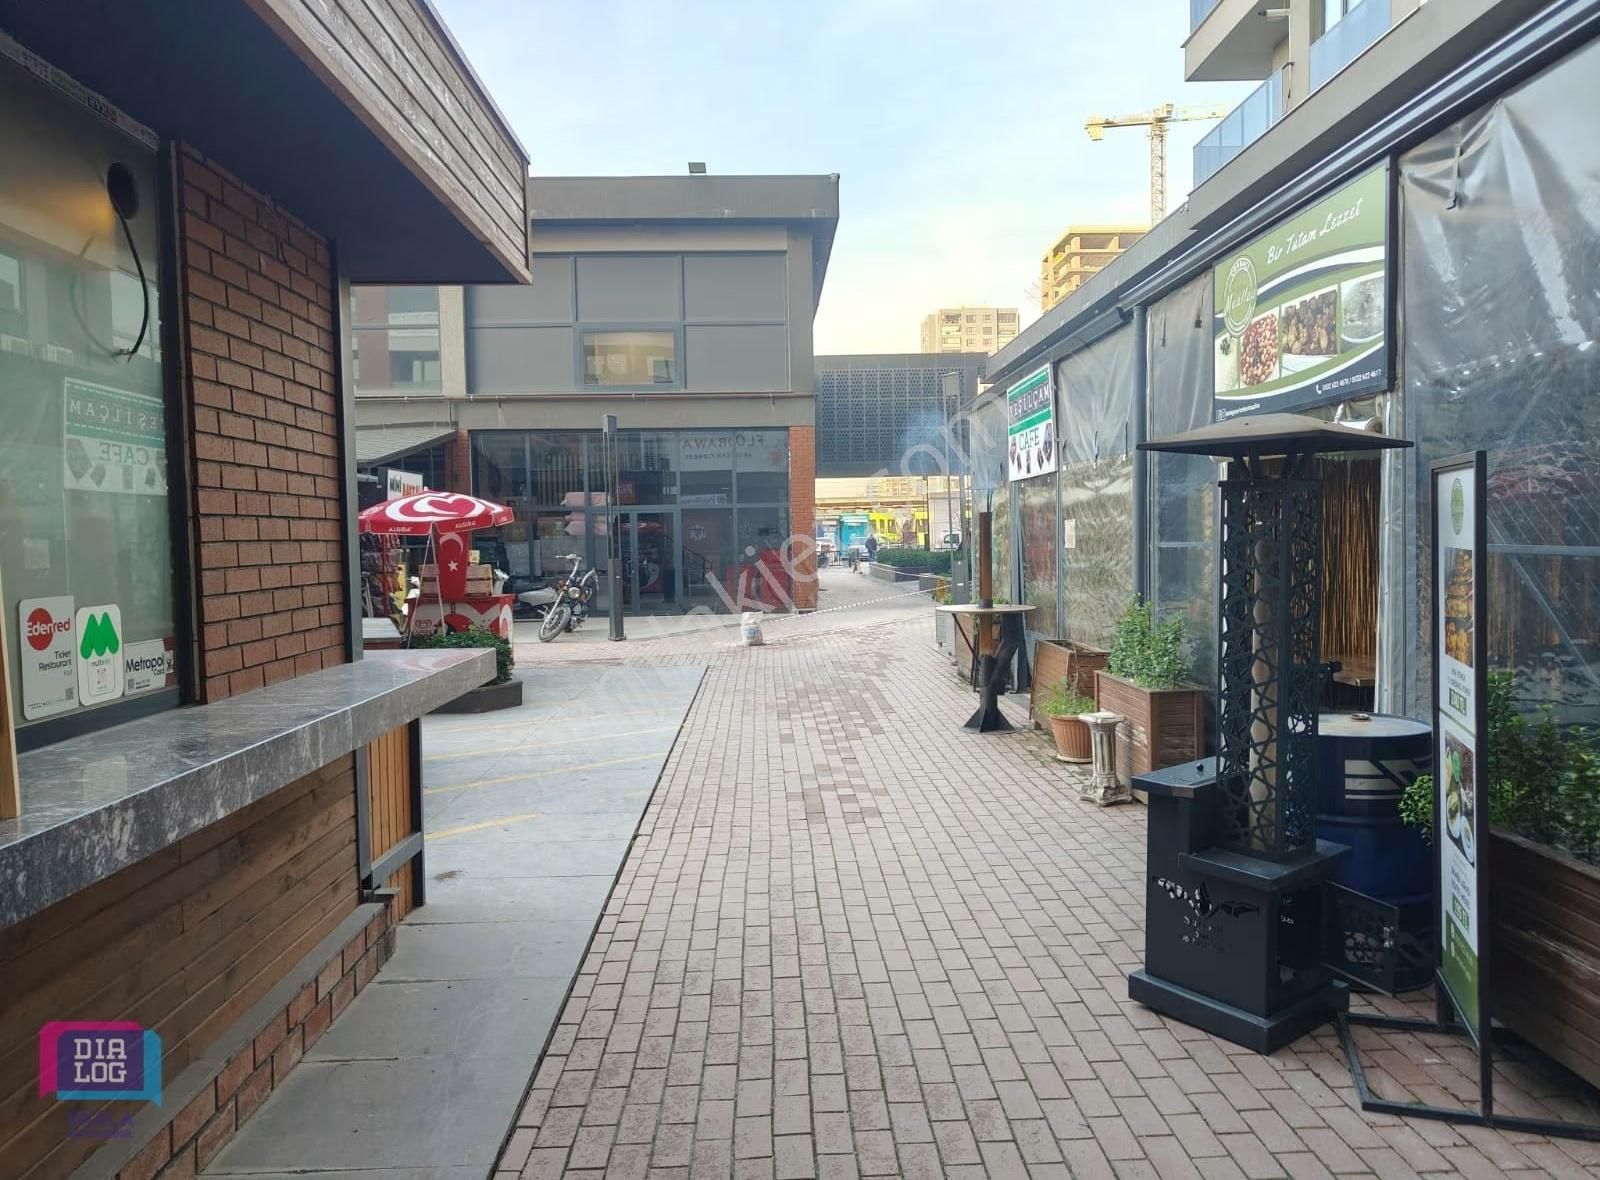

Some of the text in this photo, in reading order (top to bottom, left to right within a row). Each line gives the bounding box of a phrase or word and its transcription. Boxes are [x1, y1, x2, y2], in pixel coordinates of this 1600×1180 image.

[1267, 197, 1363, 264] Bir Tutam Lezzet
[1019, 427, 1040, 451] CAFE
[27, 617, 71, 637] Edenred
[38, 658, 72, 672] Restaurant
[125, 652, 165, 673] Metropol
